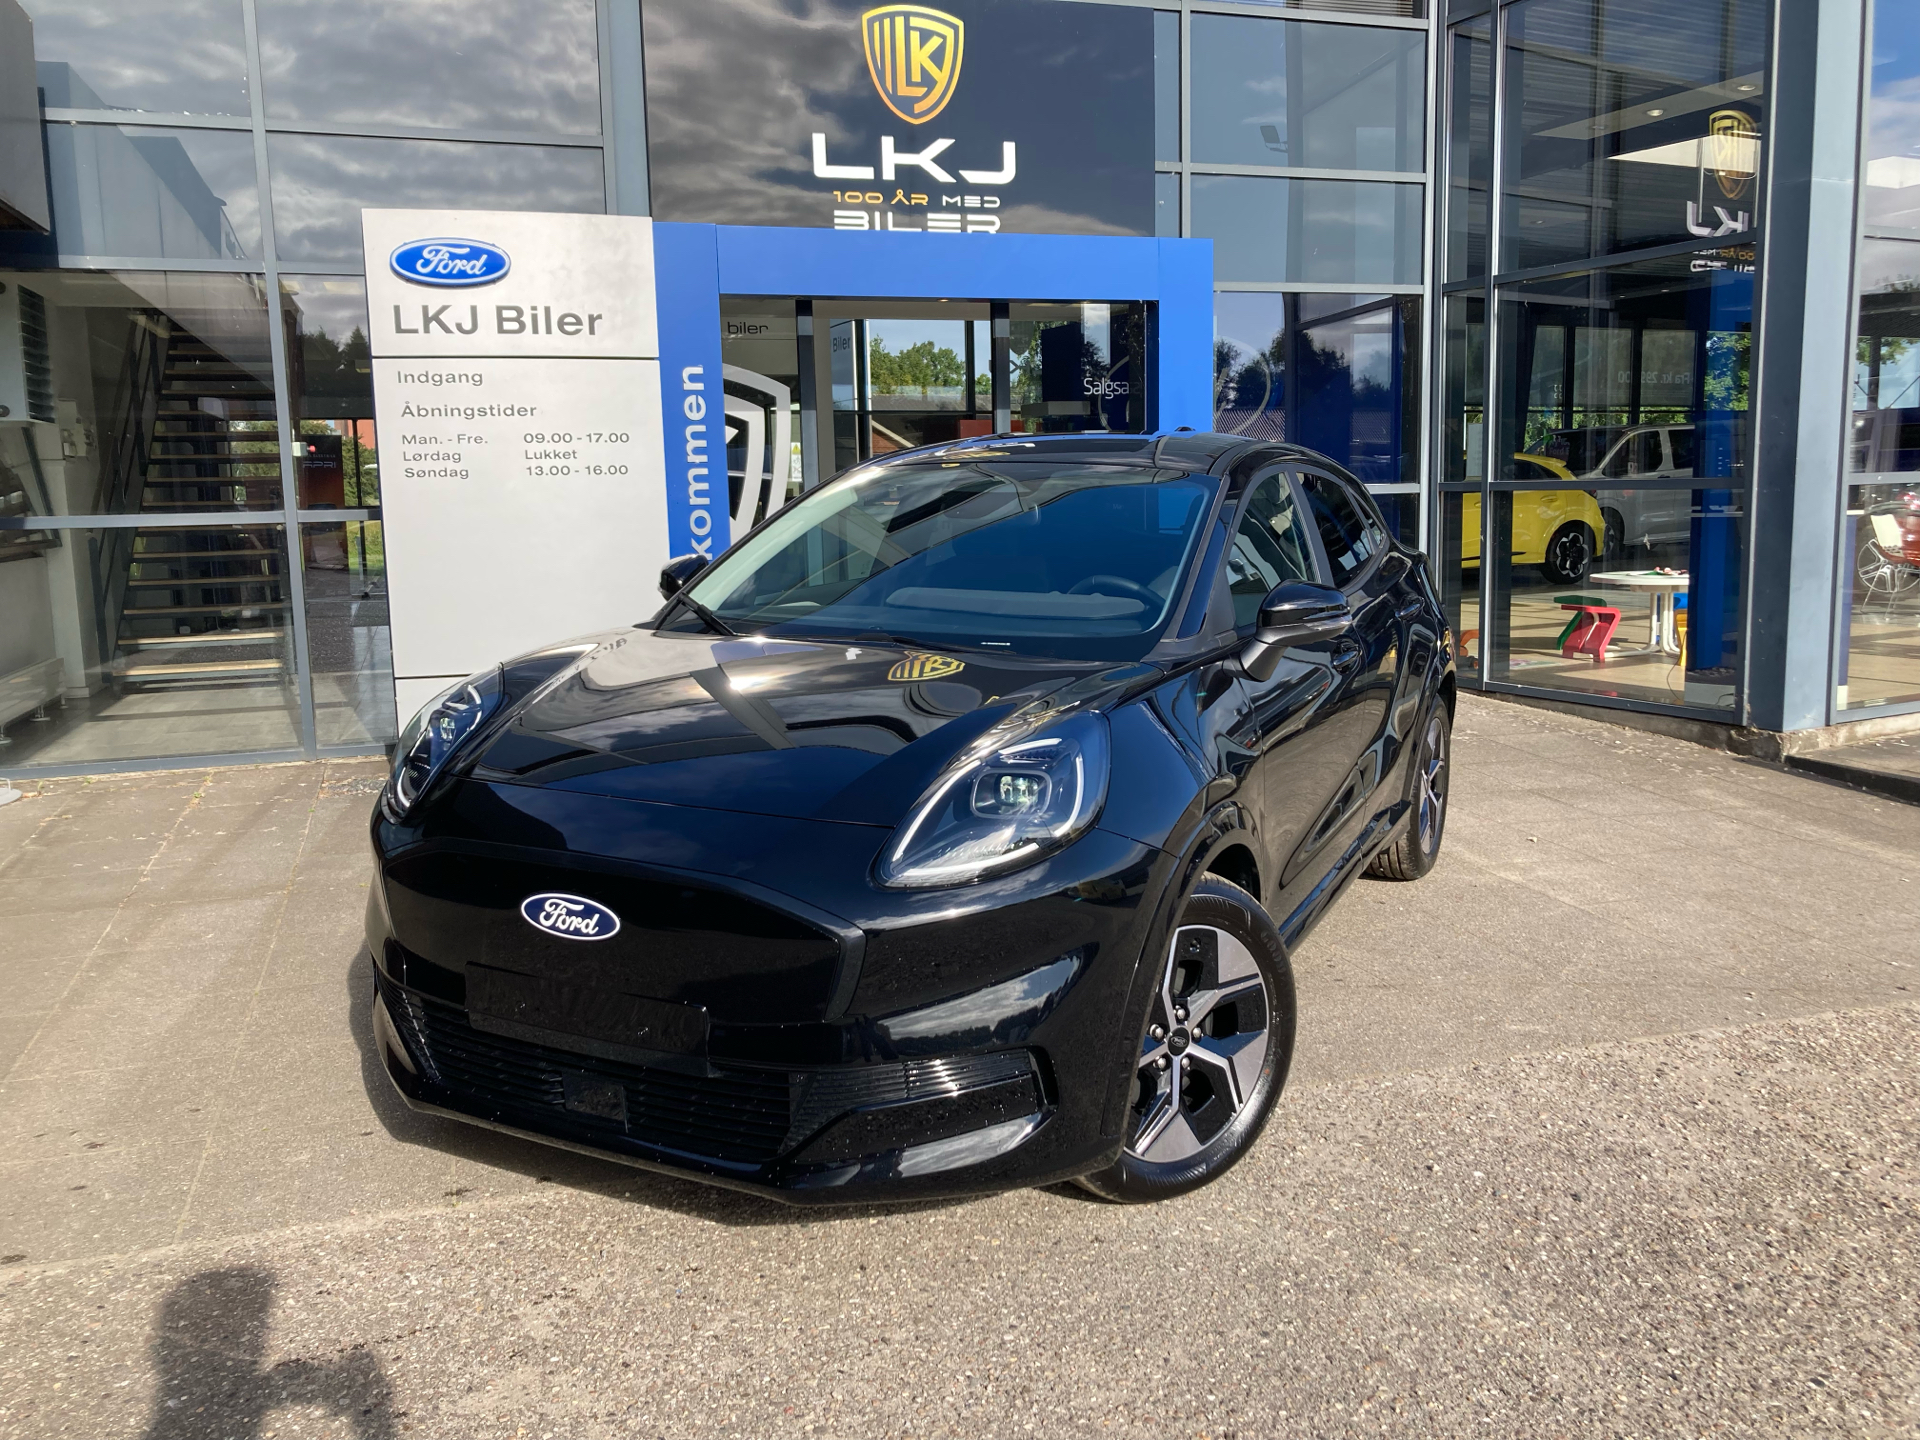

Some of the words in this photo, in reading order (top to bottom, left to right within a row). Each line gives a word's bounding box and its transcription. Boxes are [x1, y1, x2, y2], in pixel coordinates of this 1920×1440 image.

[811, 132, 1016, 185] LKJ
[833, 190, 884, 204] 100
[890, 189, 929, 206] ÅR
[942, 194, 1001, 208] MED
[833, 209, 1001, 234] BILER
[415, 245, 488, 275] Ford
[393, 304, 479, 335] LKJ
[495, 305, 603, 336] Biler
[727, 321, 769, 334] biler
[397, 370, 484, 387] Indgang
[400, 400, 537, 420] Åbningstider
[401, 434, 443, 445] Man.
[457, 433, 489, 445] Fre.
[523, 432, 573, 444] 09.00
[585, 432, 630, 444] 17.00
[403, 450, 462, 463] Lørdag
[524, 449, 578, 460] Lukket
[404, 467, 470, 480] Søndag
[526, 465, 571, 476] 13.00
[584, 464, 629, 476] 16.00
[540, 898, 600, 935] Ford
